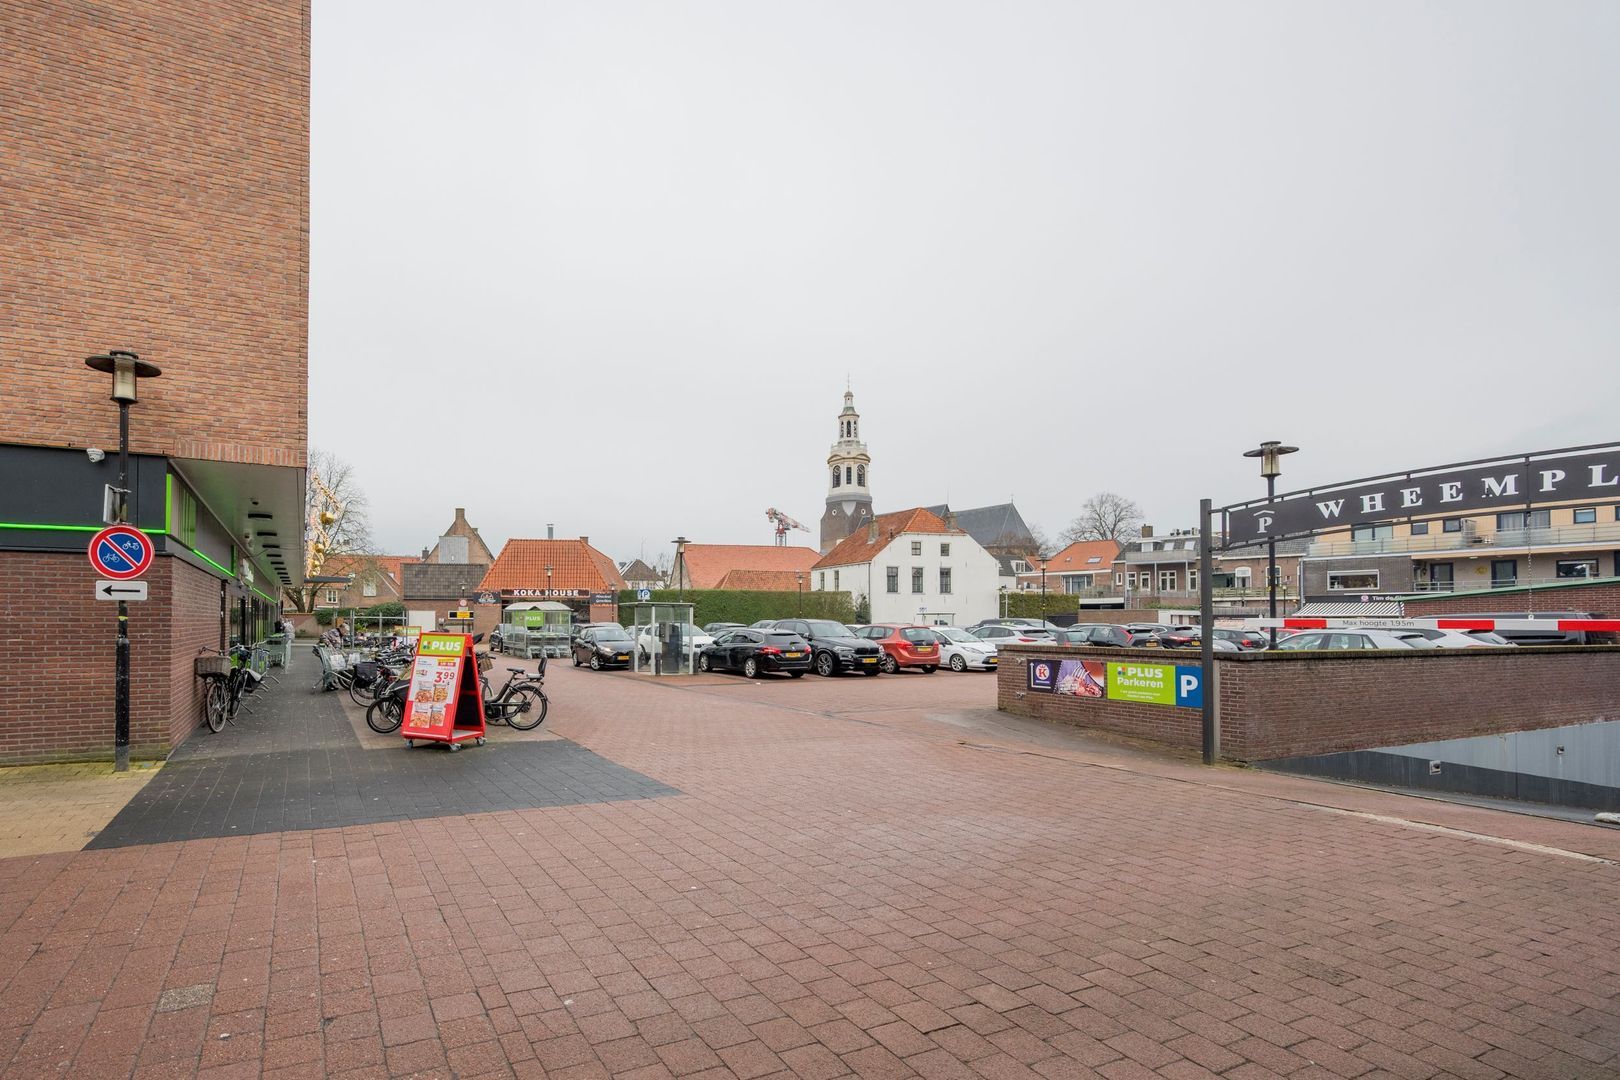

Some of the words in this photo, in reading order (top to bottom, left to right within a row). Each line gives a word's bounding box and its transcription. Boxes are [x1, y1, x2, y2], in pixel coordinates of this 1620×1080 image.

[1257, 516, 1273, 534] P
[513, 589, 540, 597] KOKA
[545, 589, 579, 597] HOUSE
[1360, 620, 1387, 628] hoogte
[431, 640, 462, 652] PLUS
[434, 671, 455, 684] 3.99
[1127, 667, 1164, 678] PLUS
[1117, 677, 1164, 689] Parkeren
[1180, 674, 1199, 698] P
